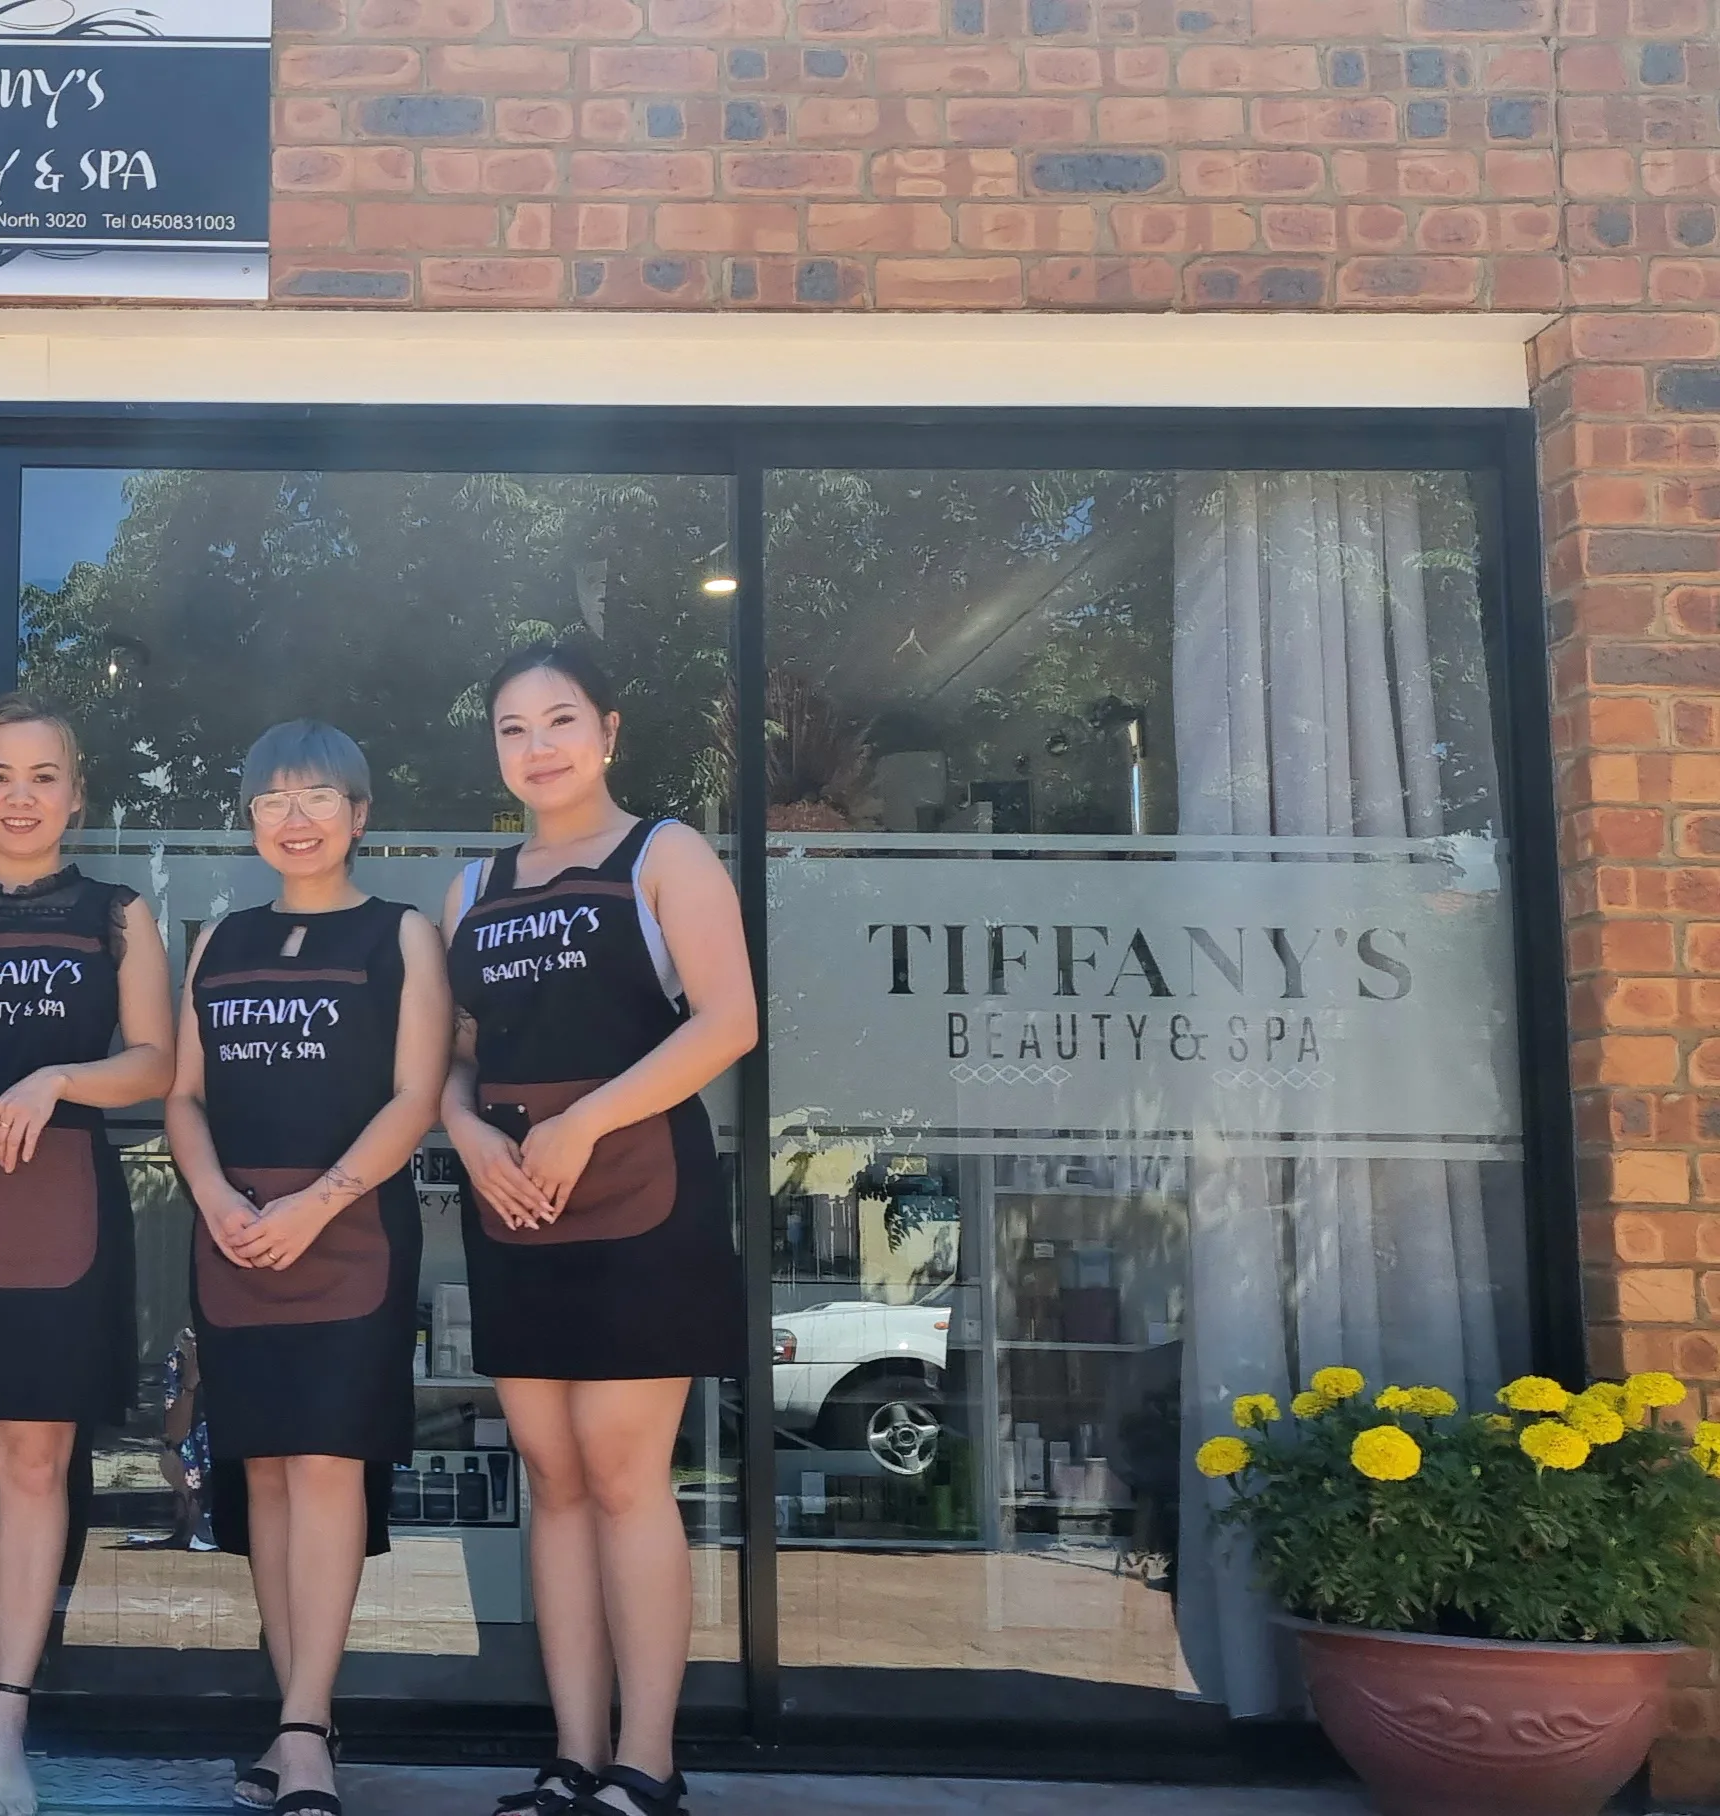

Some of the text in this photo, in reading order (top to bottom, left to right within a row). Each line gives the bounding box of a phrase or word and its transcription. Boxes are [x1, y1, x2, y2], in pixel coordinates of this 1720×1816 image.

[34, 149, 65, 193] &
[79, 148, 157, 191] SPA
[45, 212, 87, 228] 3020
[101, 213, 126, 229] Tel
[131, 214, 236, 231] 0450831003
[473, 906, 600, 952] TIFFANY'S
[482, 950, 587, 984] BEAUTY & SPA
[867, 923, 1413, 1001] TIFFANY'S
[23, 1000, 35, 1017] &
[37, 999, 66, 1018] SPA
[207, 998, 340, 1037] TIFFANY'S
[219, 1041, 326, 1066] BEAUTY & SPA
[1228, 1014, 1321, 1064] SPA
